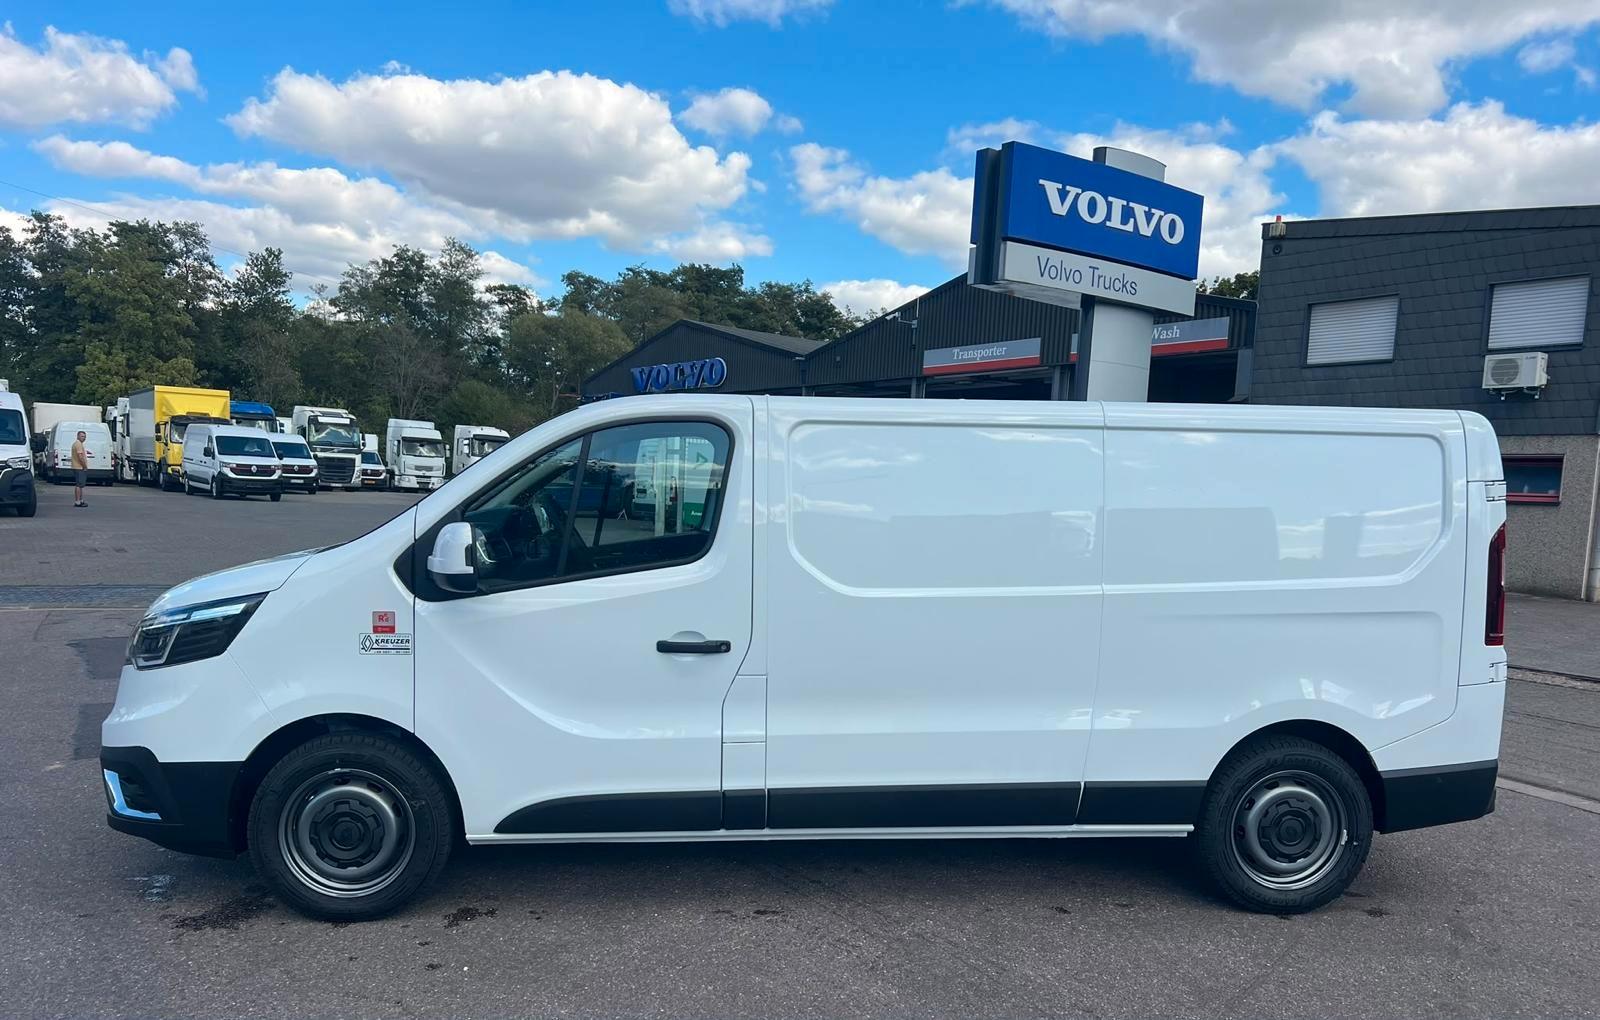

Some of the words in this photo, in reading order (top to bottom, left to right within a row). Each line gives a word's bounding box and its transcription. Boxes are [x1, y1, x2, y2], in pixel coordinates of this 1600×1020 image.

[1039, 179, 1184, 244] VOLVO
[1037, 255, 1083, 285] Volvo
[1089, 265, 1138, 296] Trucks
[952, 345, 1007, 361] Transporter
[630, 357, 727, 392] VOLVO
